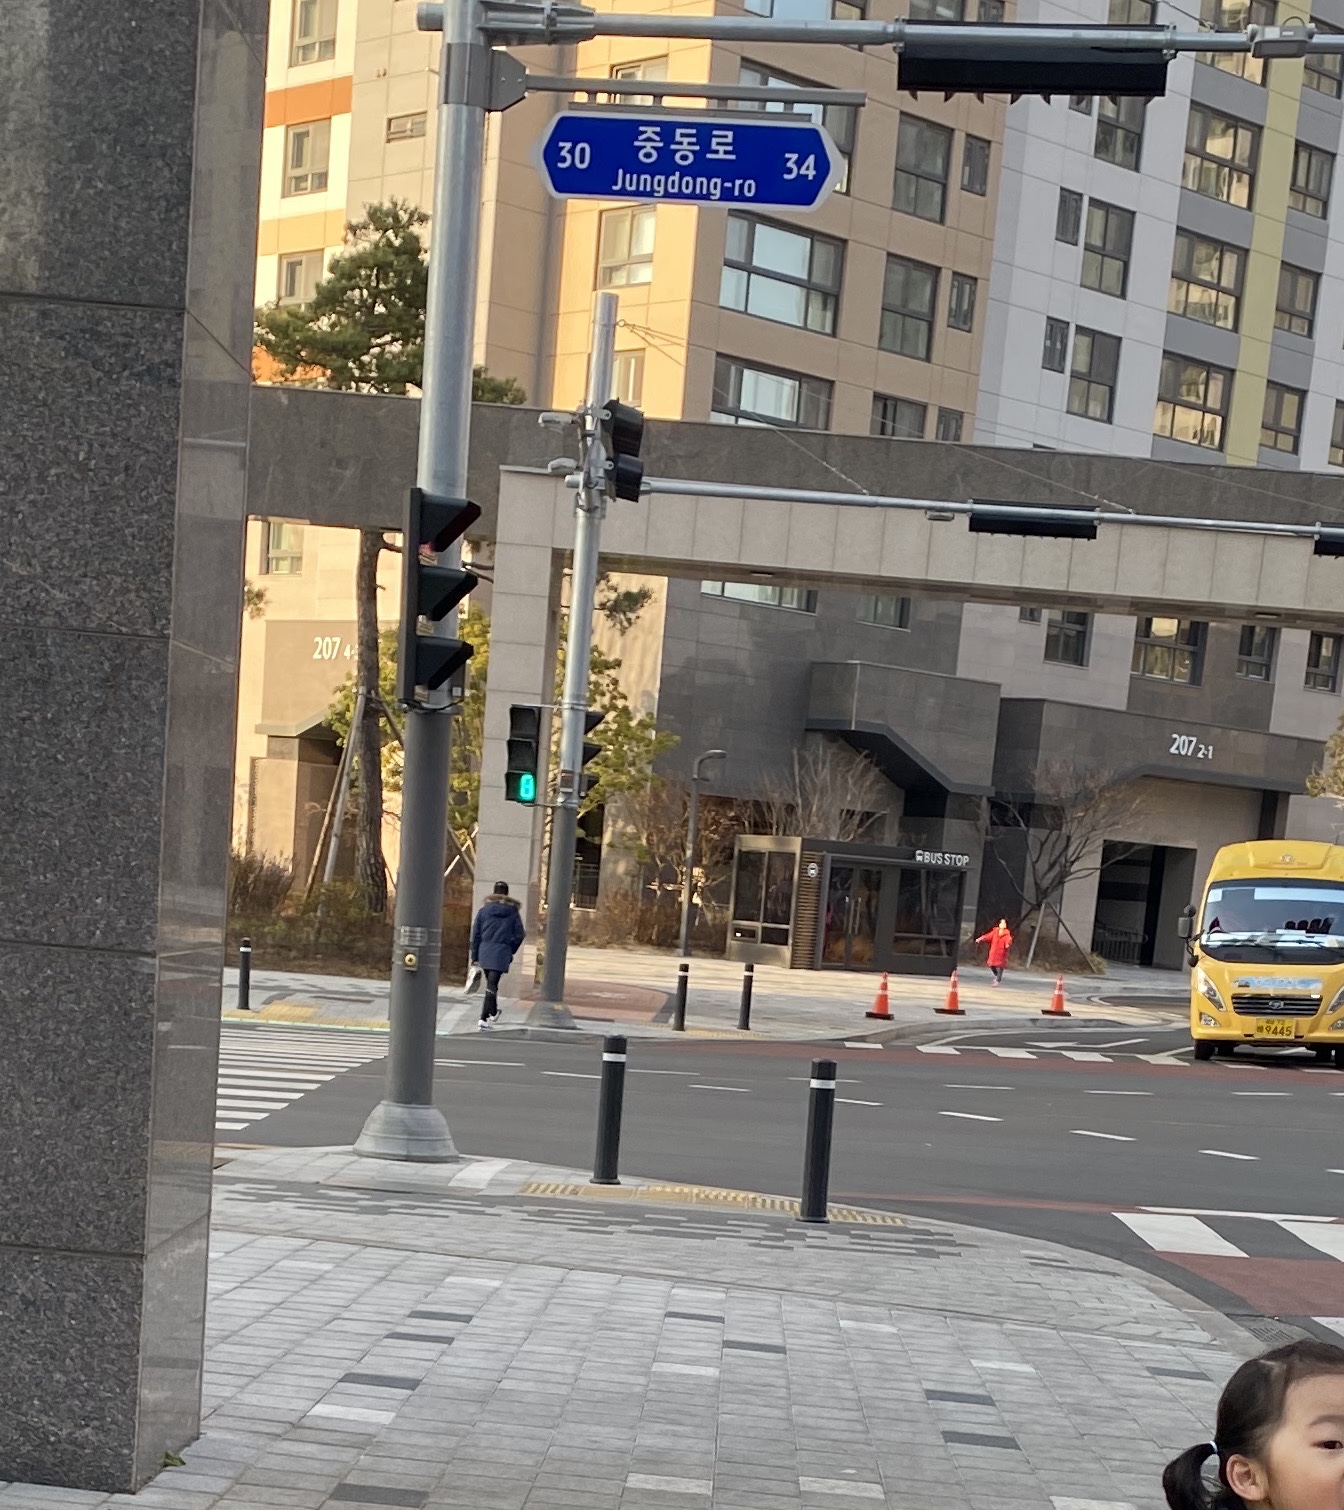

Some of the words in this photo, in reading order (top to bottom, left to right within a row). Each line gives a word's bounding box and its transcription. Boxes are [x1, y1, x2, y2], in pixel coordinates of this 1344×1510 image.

[557, 142, 591, 169] 30
[633, 126, 737, 165] 중동로
[782, 153, 817, 180] 34
[611, 169, 757, 199] Jungdong-ro
[312, 636, 341, 660] 207
[1169, 733, 1197, 757] 207
[1197, 744, 1213, 760] 2-1
[924, 850, 944, 865] BUS
[944, 853, 970, 867] STOP
